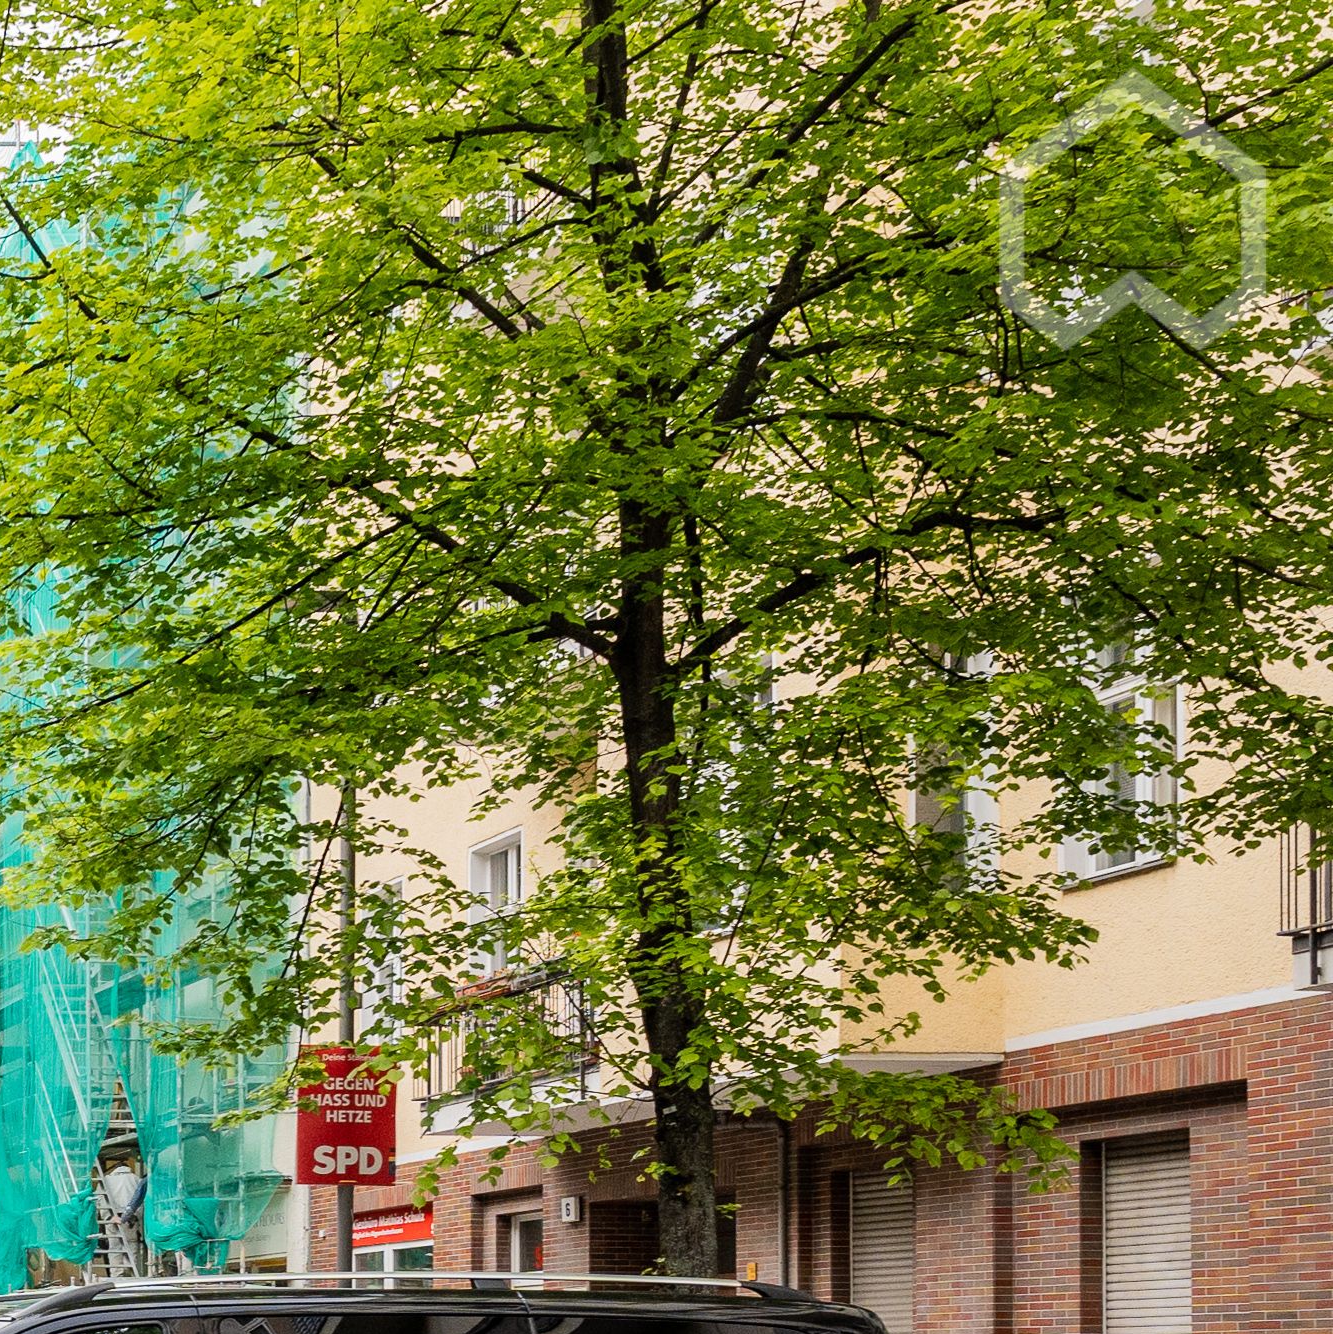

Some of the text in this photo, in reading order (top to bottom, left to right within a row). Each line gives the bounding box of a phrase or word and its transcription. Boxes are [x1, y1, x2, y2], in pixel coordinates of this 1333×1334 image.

[323, 1077, 375, 1091] GEGEN
[309, 1093, 387, 1108] HASS UND
[325, 1109, 373, 1123] HETZE
[312, 1145, 383, 1175] SPD
[565, 1202, 571, 1217] 6
